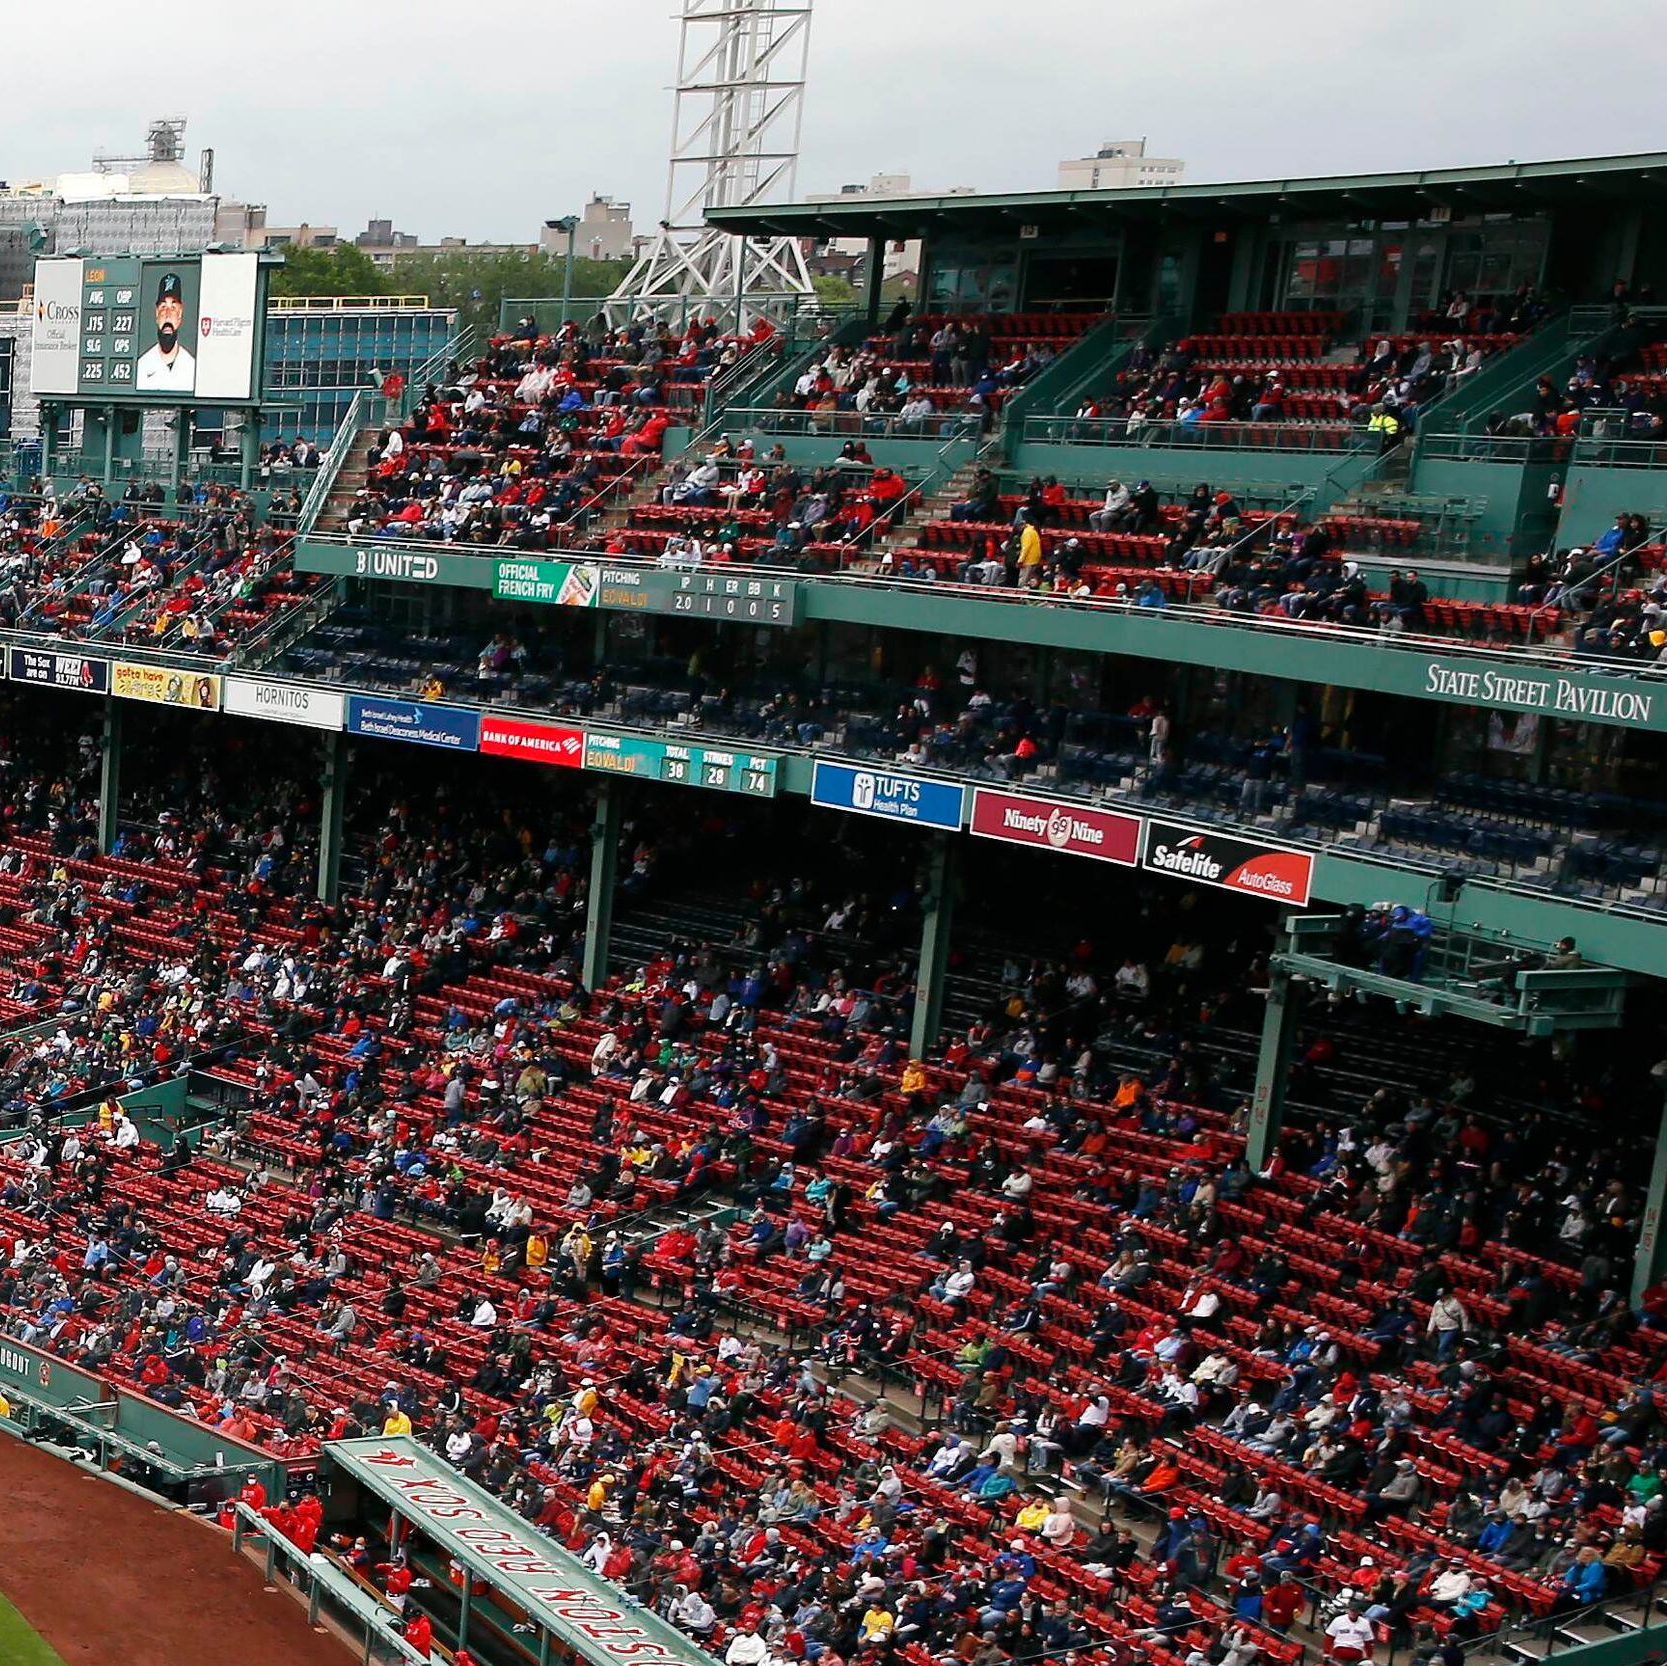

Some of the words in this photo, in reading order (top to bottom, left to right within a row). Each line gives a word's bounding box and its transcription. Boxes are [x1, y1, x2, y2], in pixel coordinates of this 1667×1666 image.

[86, 316, 104, 332] .175
[112, 316, 133, 332] .227
[86, 340, 102, 353] SLG
[114, 339, 130, 353] OPS
[82, 363, 103, 380] .225
[110, 363, 131, 380] .452
[498, 563, 541, 583] OFFICIAL
[498, 581, 535, 597] FRENCH
[535, 583, 554, 600] FRY
[24, 654, 37, 667] The
[36, 656, 51, 669] Sox
[116, 667, 141, 681] gotta
[142, 668, 164, 682] have
[256, 686, 310, 710] HORNITOS
[1425, 663, 1479, 698] STATE
[1480, 671, 1550, 707] STREET
[1553, 679, 1652, 722] PAVILION
[483, 731, 508, 745] BANK
[508, 735, 521, 746] OF
[521, 736, 561, 752] AMERICA
[668, 761, 684, 779] 38
[707, 767, 725, 785] 28
[749, 774, 765, 791] 74
[875, 776, 921, 803] TUFTS
[873, 800, 899, 815] Health
[900, 803, 918, 818] Plan
[1003, 808, 1046, 835] Ninety
[1071, 821, 1104, 845] Nine
[1152, 844, 1221, 880] Safelite
[1237, 866, 1293, 896] AutoGlass
[386, 1473, 492, 1523] SOX
[451, 1527, 564, 1578] RED
